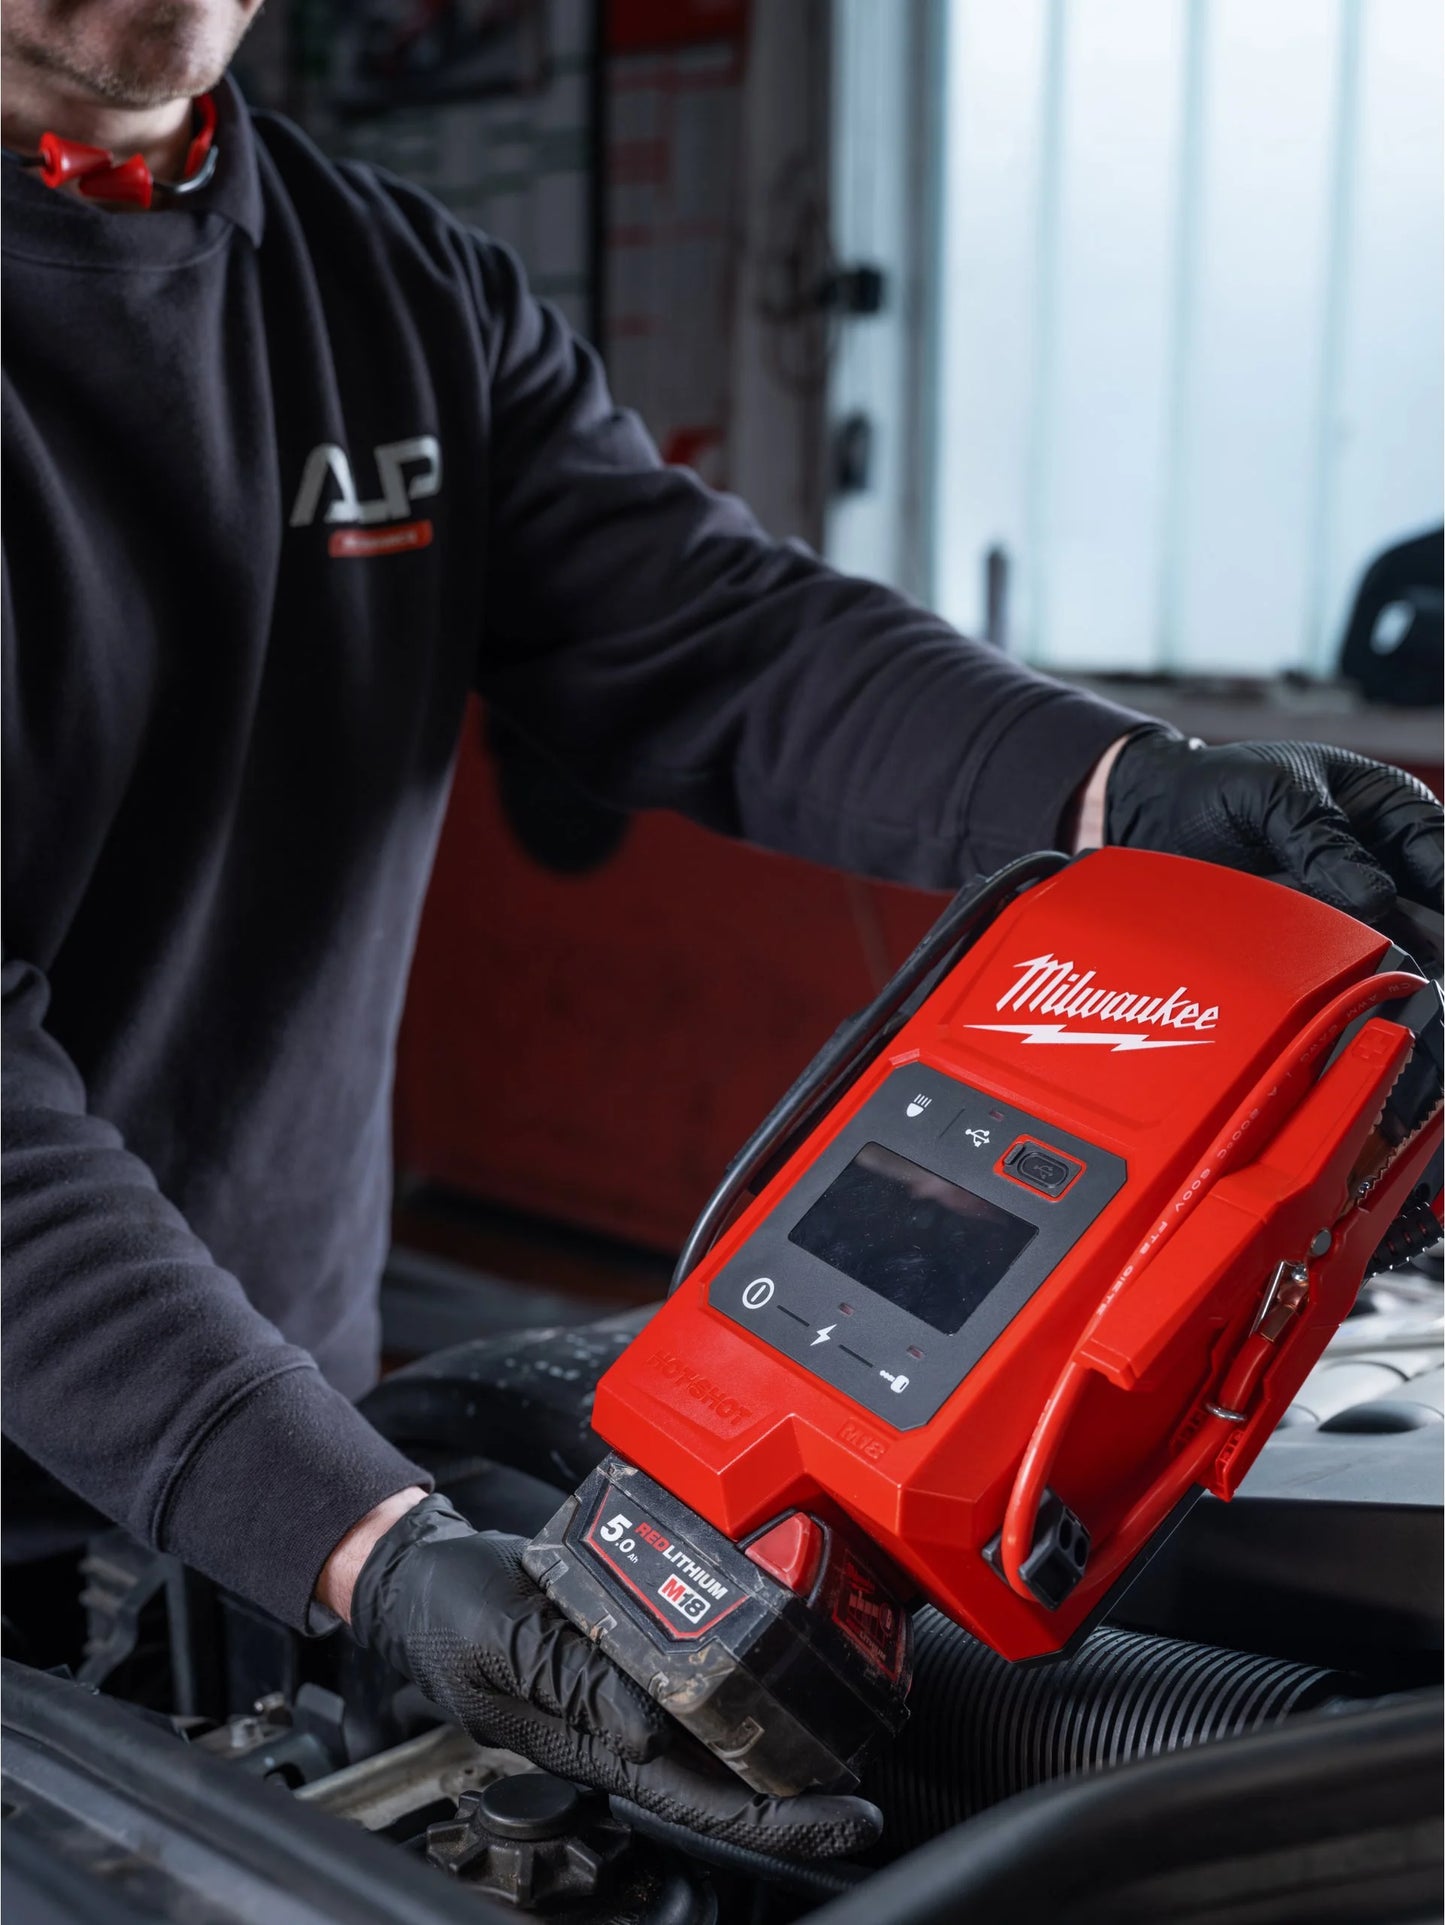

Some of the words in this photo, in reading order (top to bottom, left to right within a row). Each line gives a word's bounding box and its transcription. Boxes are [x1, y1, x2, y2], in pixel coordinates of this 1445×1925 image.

[996, 953, 1219, 1030] Milwaukee
[634, 1522, 728, 1600] REDLITHIUM
[661, 1578, 707, 1618] M18
